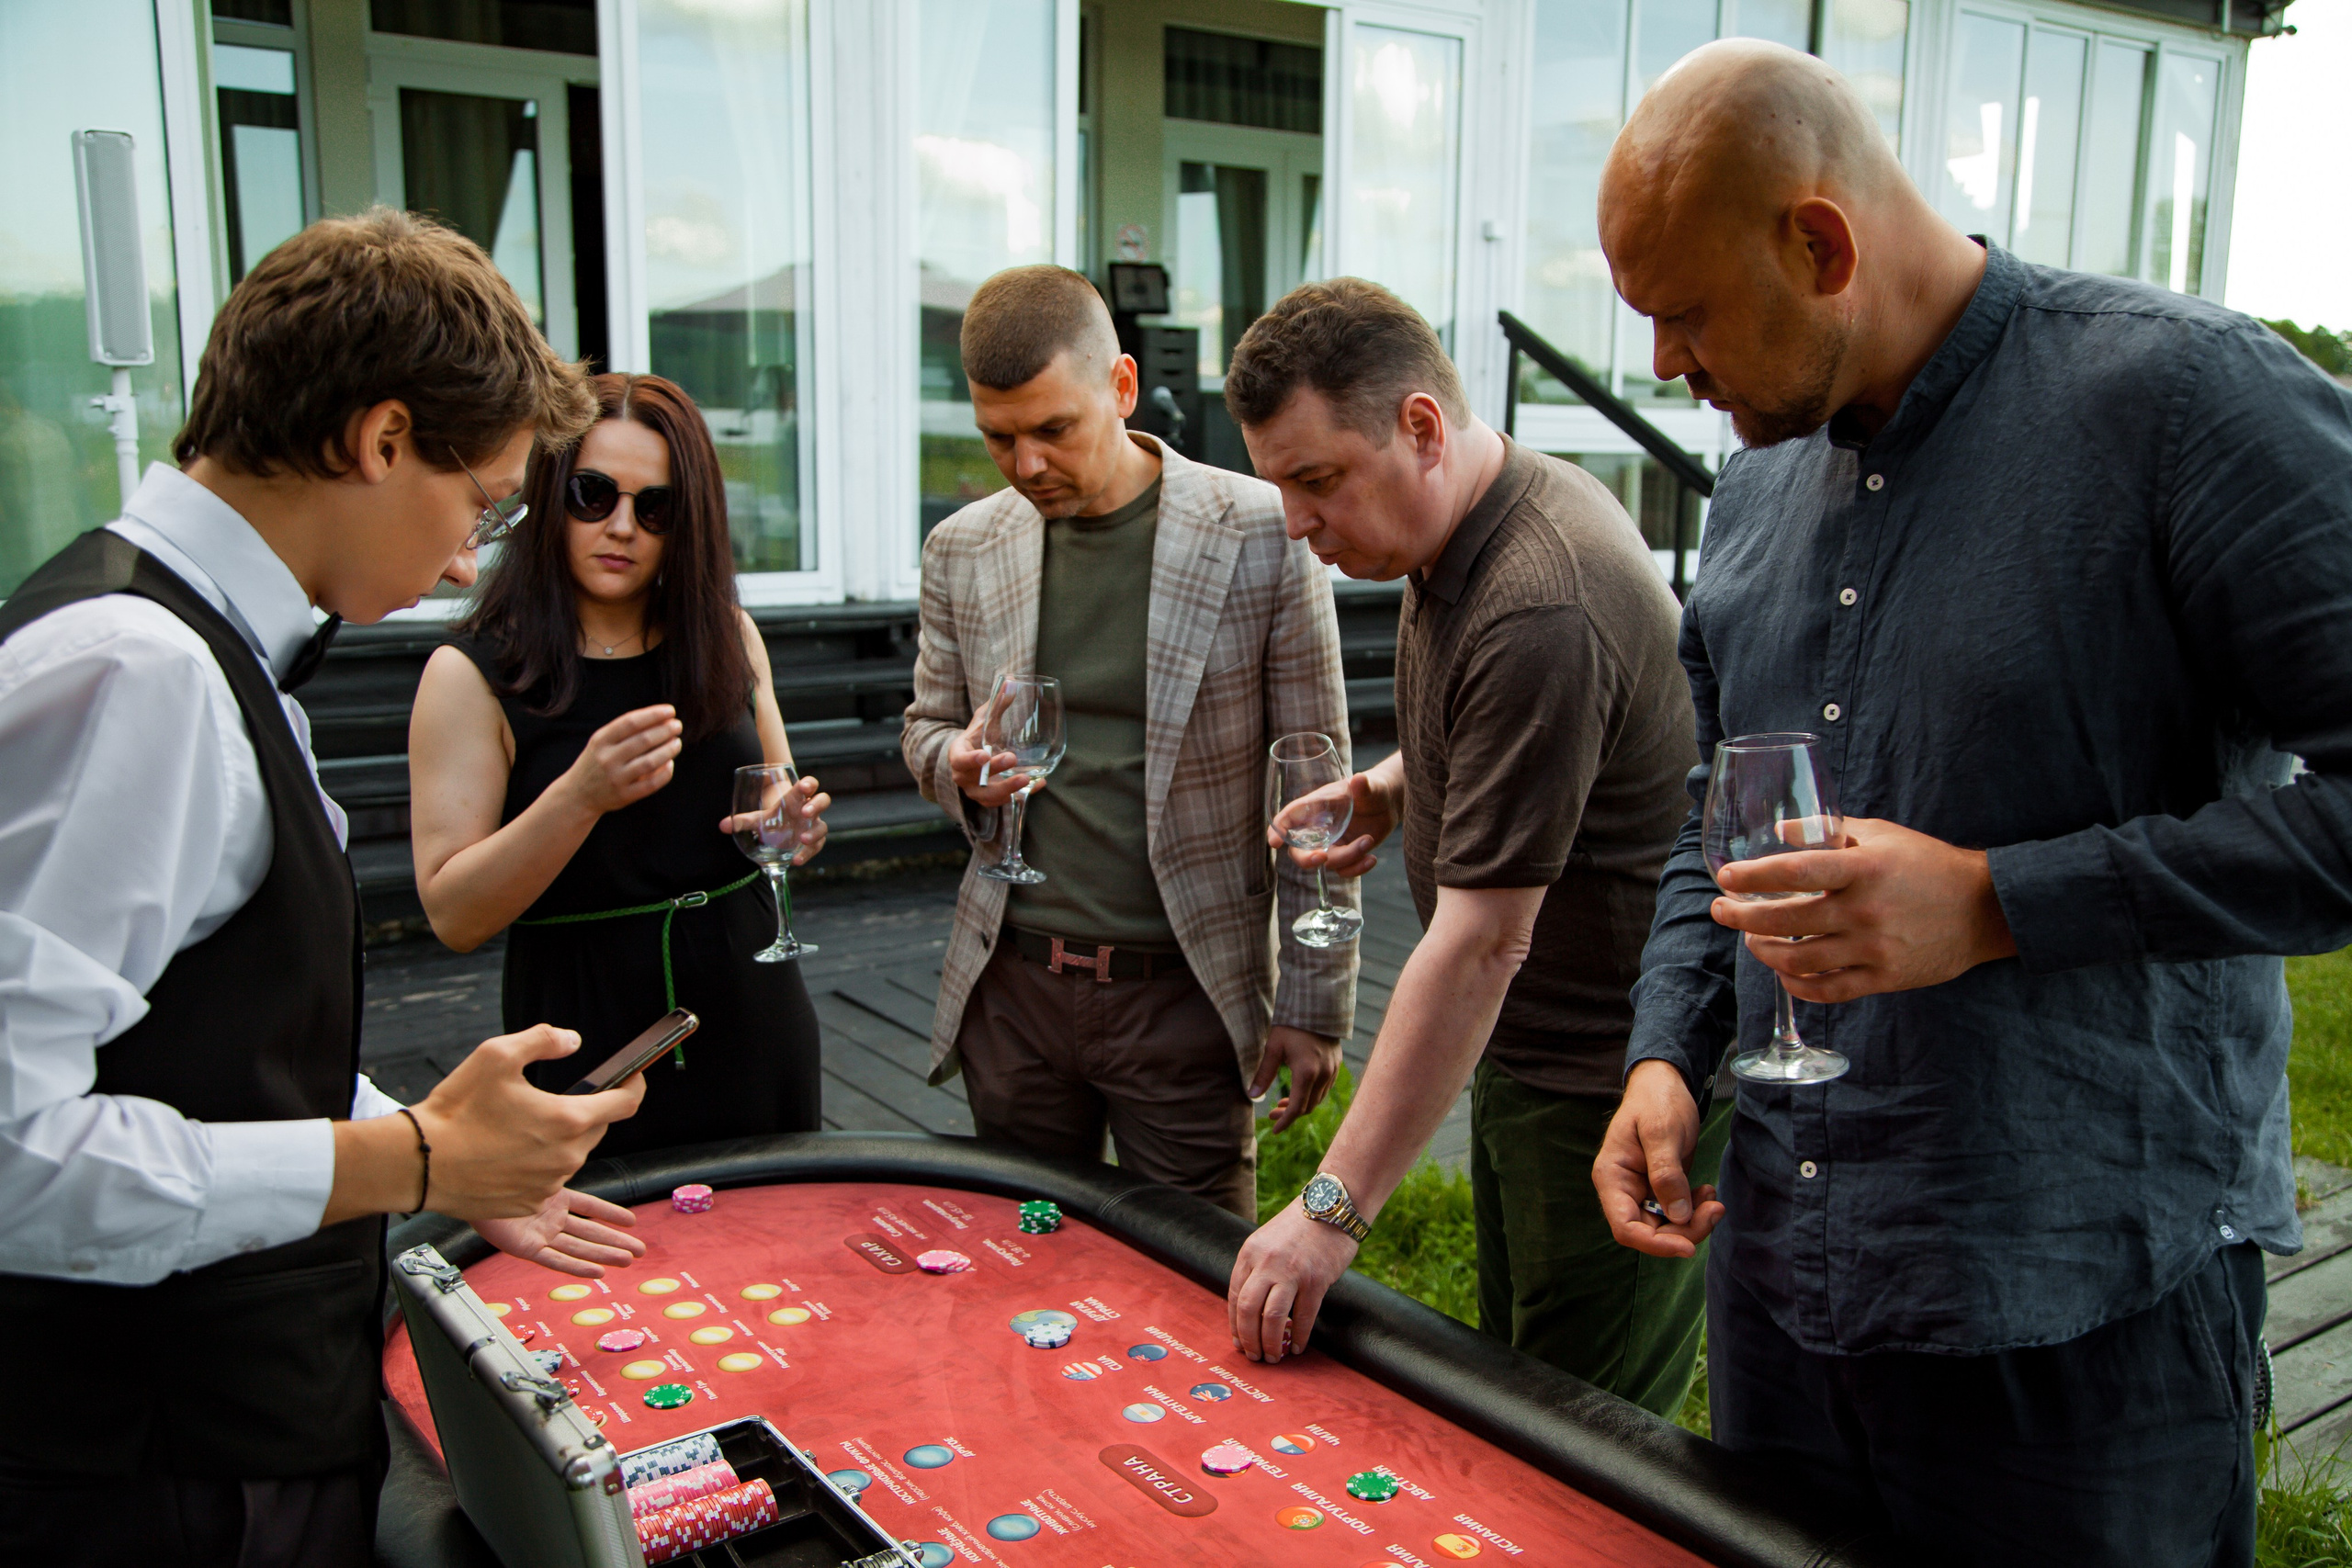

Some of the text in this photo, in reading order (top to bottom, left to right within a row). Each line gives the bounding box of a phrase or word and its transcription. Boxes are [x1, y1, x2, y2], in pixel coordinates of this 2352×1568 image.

[861, 1242, 903, 1266] САХАР
[1069, 1301, 1111, 1322] ДРУГАЯ
[1084, 1296, 1121, 1319] СТРАНА
[1144, 1325, 1209, 1363] Н.ЗЕЛАНДИЯ
[1097, 1355, 1123, 1371] США
[1208, 1365, 1275, 1403] АВСТРАЛИЯ
[1143, 1384, 1206, 1424] АРГЕНТИНА
[944, 1437, 977, 1458] ДРУГОЕ
[1305, 1424, 1340, 1447] ЧИЛИ
[840, 1441, 917, 1506] КОСТОЧКОВЫЕ ФРУКТЫ
[1123, 1456, 1193, 1504] СТРАНА
[932, 1506, 954, 1521] кофе)
[1020, 1499, 1069, 1535] ЖИВОТНЫЕ
[1036, 1495, 1083, 1531] (сливки, кожа,
[1042, 1489, 1097, 1529] мускус, шерсть)
[1291, 1482, 1374, 1536] ПОРТУГАЛИЯ
[937, 1528, 982, 1563] КОПЧЁНЫЕ
[949, 1520, 970, 1536] хлеб,
[1453, 1513, 1524, 1556] ИСПАНИЯ
[966, 1535, 998, 1561] жареный
